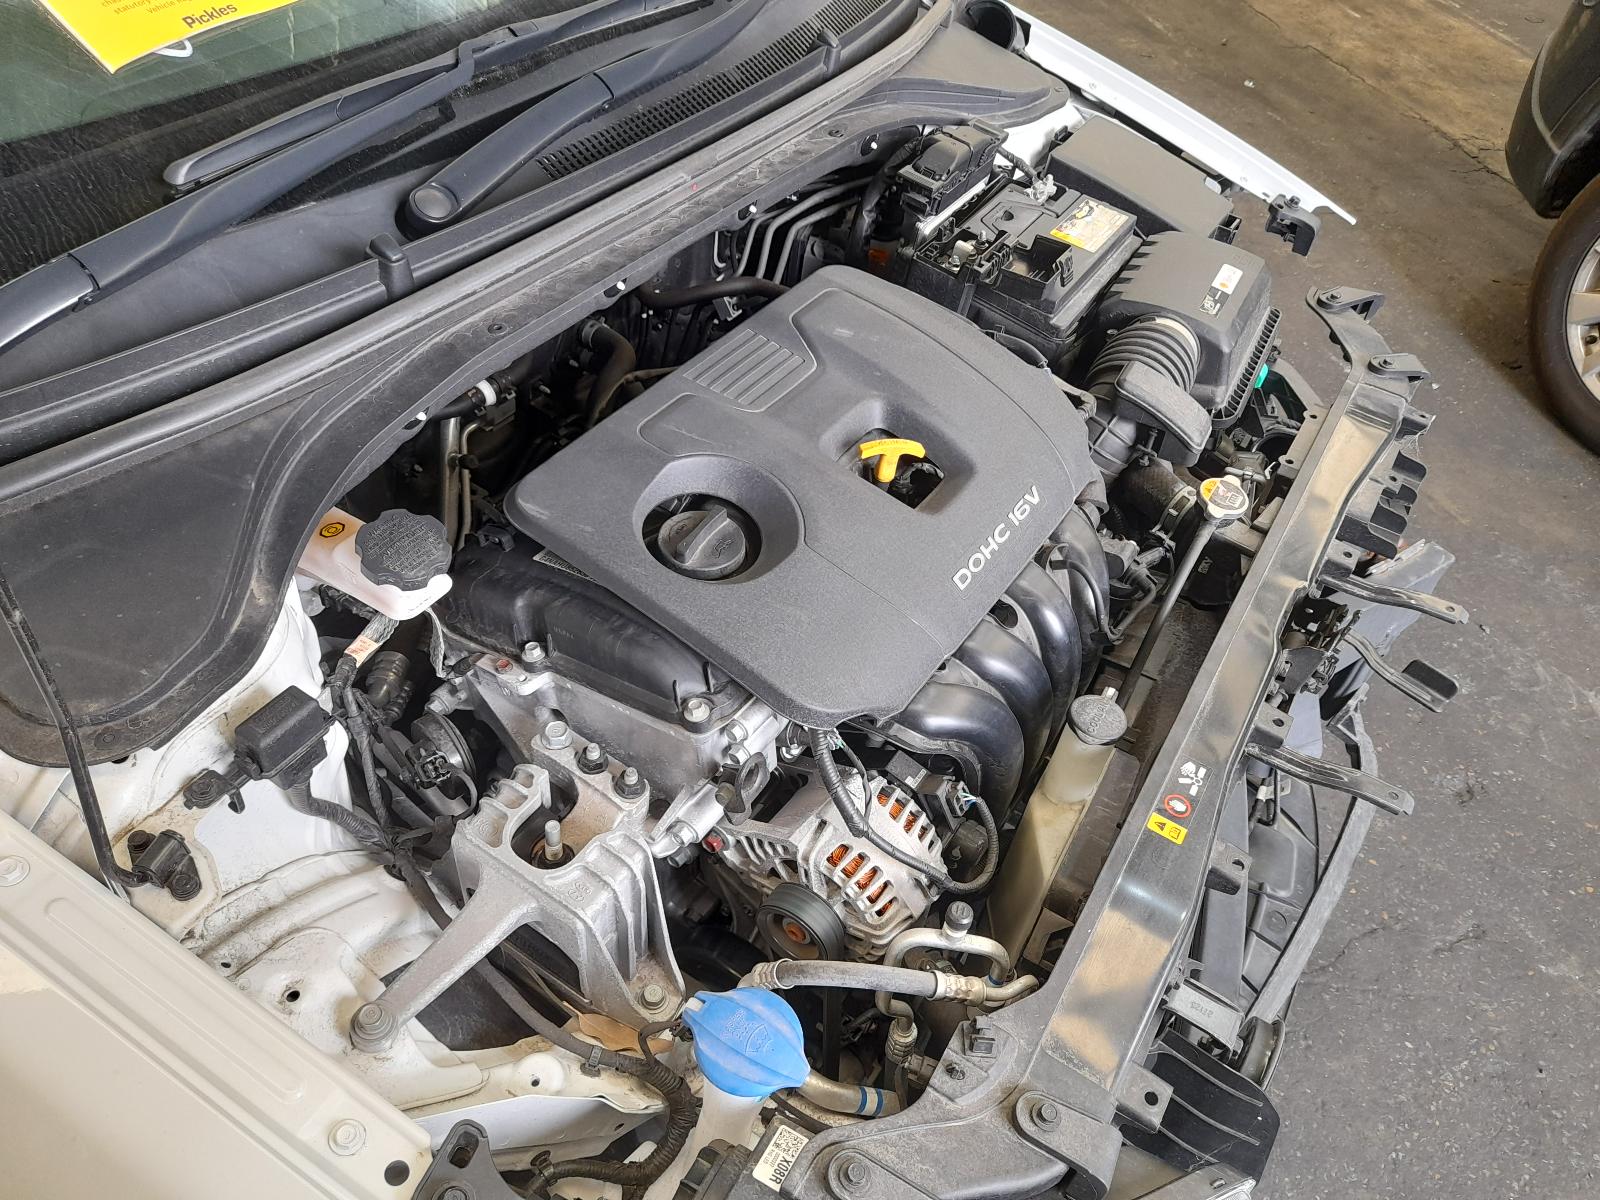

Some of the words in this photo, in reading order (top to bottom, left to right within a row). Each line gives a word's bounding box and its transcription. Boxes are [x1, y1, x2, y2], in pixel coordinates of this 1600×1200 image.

[182, 4, 238, 28] Pickles
[952, 522, 1011, 591] DOHC
[1006, 485, 1041, 527] 16V
[769, 1156, 792, 1184] X08R
